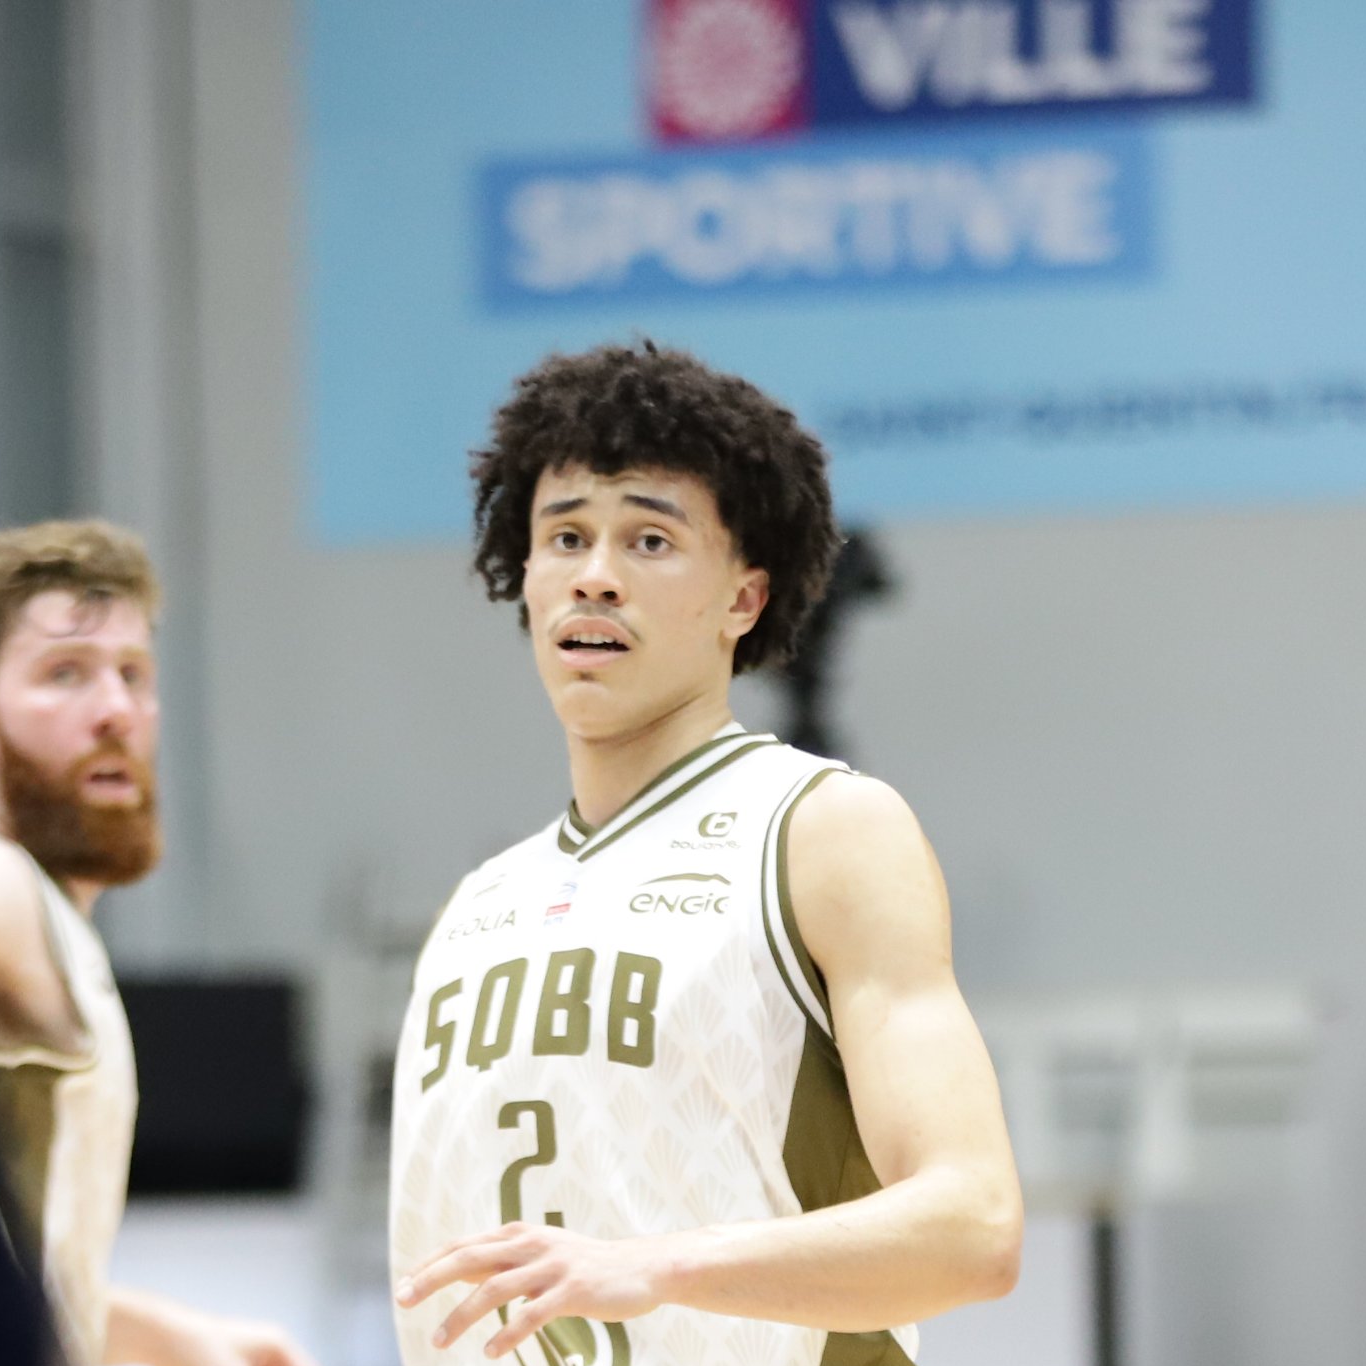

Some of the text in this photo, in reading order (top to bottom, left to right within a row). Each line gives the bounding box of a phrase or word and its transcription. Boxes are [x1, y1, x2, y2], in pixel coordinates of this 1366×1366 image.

[831, 0, 1215, 110] VILLE
[507, 150, 1121, 292] SPORTIVE
[421, 947, 663, 1094] SQBB
[498, 1100, 565, 1228] 2
